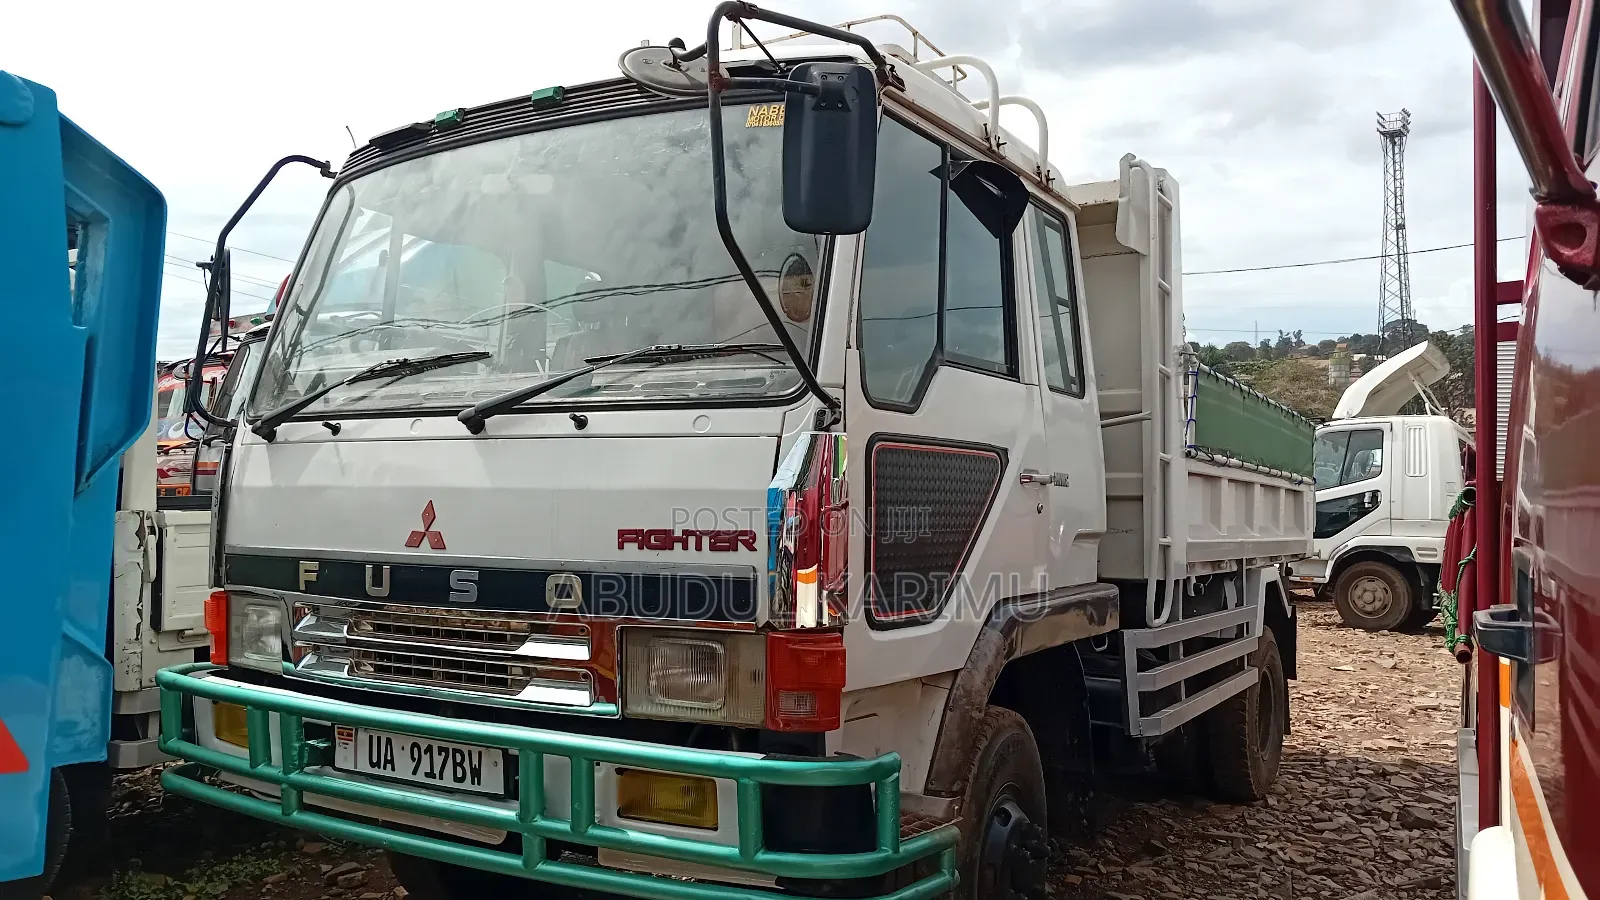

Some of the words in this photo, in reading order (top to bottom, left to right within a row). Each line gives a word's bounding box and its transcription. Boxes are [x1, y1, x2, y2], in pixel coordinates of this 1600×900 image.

[747, 114, 777, 122] MOTOR
[617, 528, 758, 552] FIGHTER
[299, 560, 583, 609] FUSO
[368, 734, 396, 772] UA
[409, 741, 483, 786] 917BW
